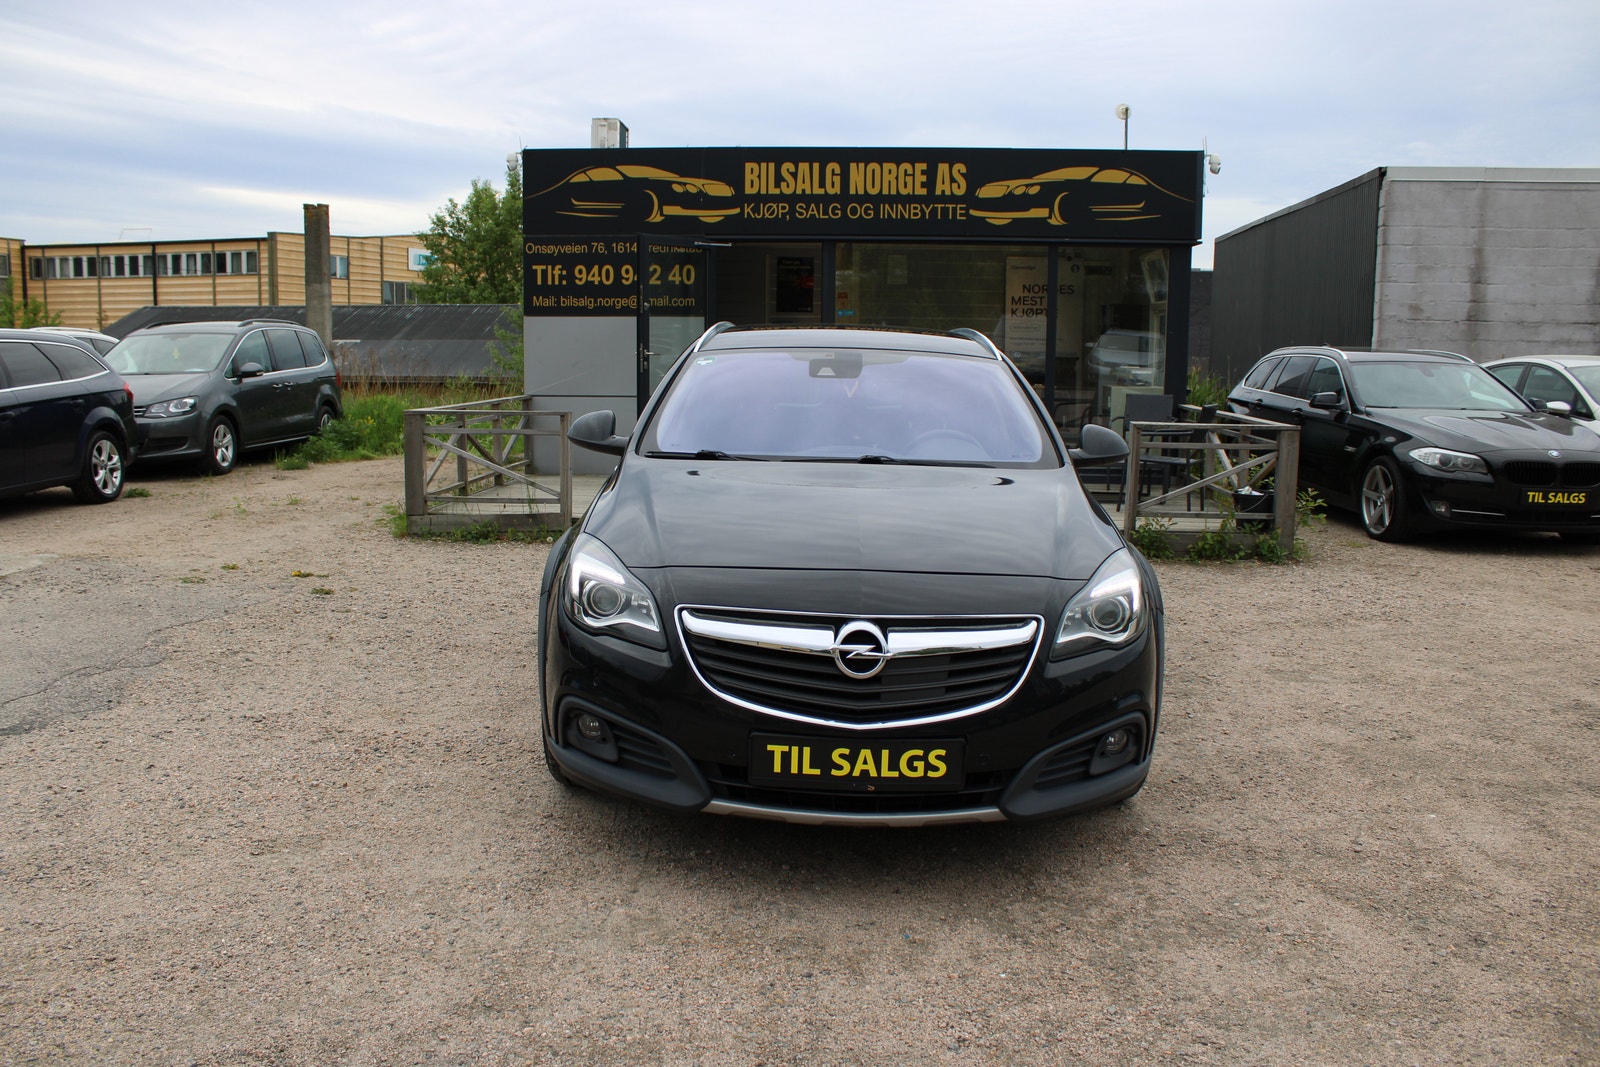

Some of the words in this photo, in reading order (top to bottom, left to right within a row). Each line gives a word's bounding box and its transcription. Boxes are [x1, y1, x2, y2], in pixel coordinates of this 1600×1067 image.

[744, 162, 841, 195] BILSALG
[850, 162, 927, 195] NORGE
[935, 163, 967, 195] AS
[744, 203, 790, 221] KJØP,
[795, 203, 841, 219] SALG
[847, 204, 874, 219] OG
[880, 204, 967, 219] INNBYTTE
[525, 242, 588, 256] Onsøyveien
[591, 242, 608, 255] 76,
[611, 242, 637, 254] 1614
[532, 264, 567, 286] Tlf:
[574, 264, 614, 286] 940
[668, 264, 696, 286] 40
[1022, 284, 1075, 295] NORES
[532, 295, 557, 308] Mail:
[560, 295, 696, 310] bilsalg.norge@mail.com
[1011, 296, 1045, 306] MEST
[1527, 491, 1545, 503] TIL
[1547, 492, 1587, 504] SALGS
[766, 744, 821, 776] TIL
[831, 747, 948, 778] SALGS
